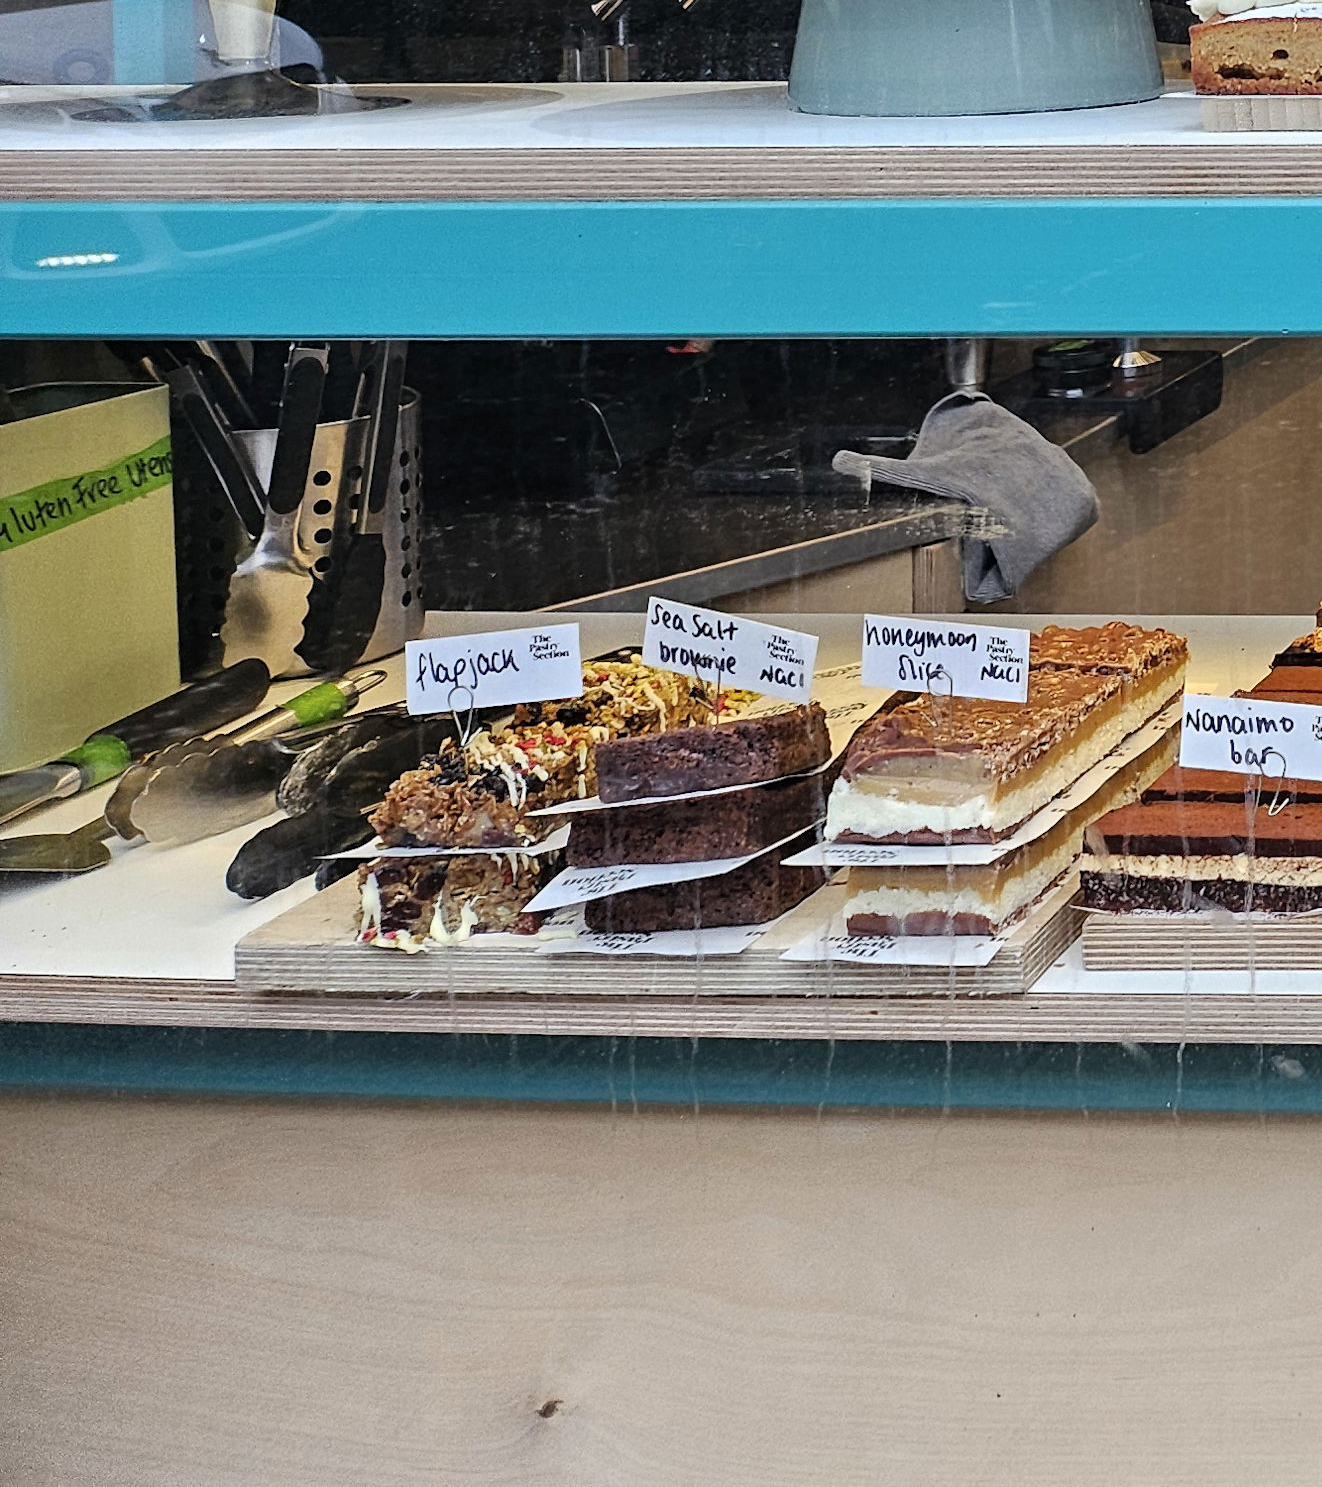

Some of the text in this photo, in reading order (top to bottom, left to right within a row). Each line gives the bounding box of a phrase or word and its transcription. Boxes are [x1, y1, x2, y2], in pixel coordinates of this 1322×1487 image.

[72, 477, 122, 509] Free
[532, 635, 552, 643] The
[772, 635, 790, 645] The
[865, 619, 976, 656] honeymoon
[990, 636, 1008, 645] The
[533, 650, 569, 661] Section
[660, 641, 736, 674] brownie
[769, 651, 804, 665] Section
[989, 653, 1024, 664] Section
[416, 649, 520, 691] flapjack
[1186, 707, 1294, 735] Nanaimo
[1230, 739, 1273, 766] bar
